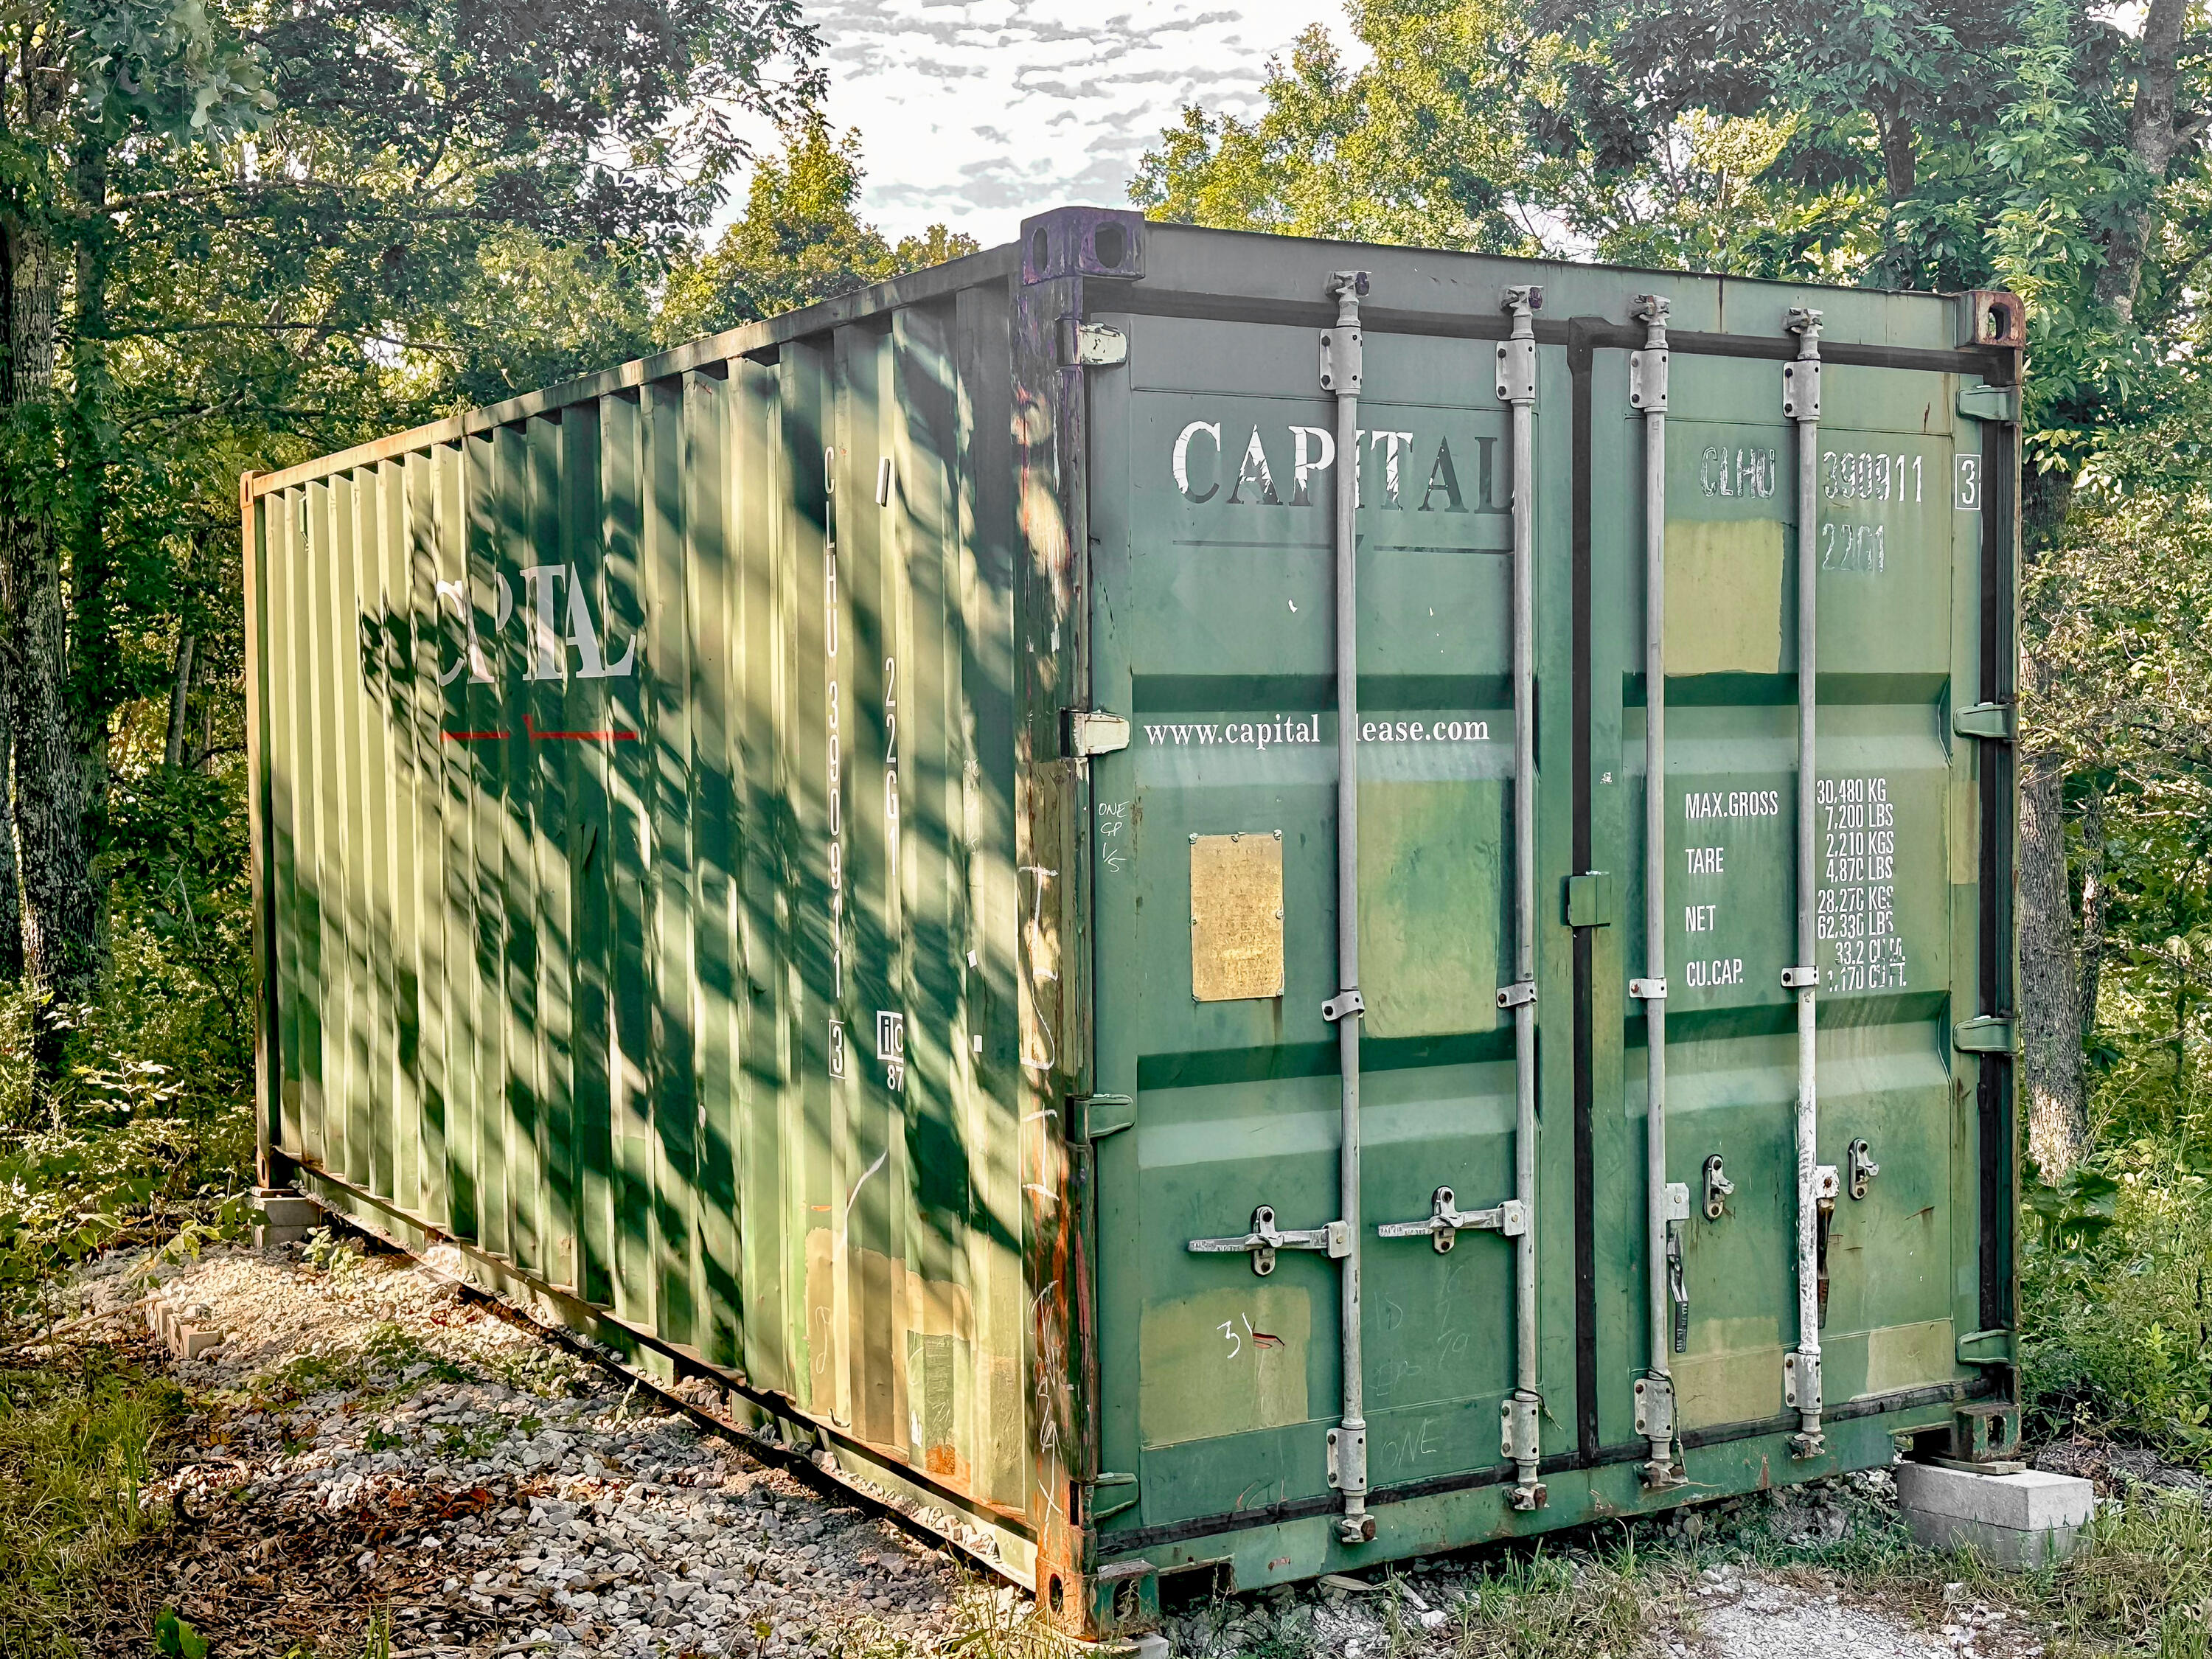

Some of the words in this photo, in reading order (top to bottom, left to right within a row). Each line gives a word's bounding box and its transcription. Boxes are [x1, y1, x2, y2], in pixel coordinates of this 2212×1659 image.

[1700, 447, 1775, 499] CLHU
[1822, 451, 1923, 504] 390911
[1961, 459, 1976, 505] 3
[1143, 713, 1321, 751] www.capital
[1099, 801, 1130, 818] ONE
[1686, 790, 1779, 820] MAX.GROSS
[1816, 779, 1864, 804] 30,480
[1868, 777, 1887, 803] KG
[1825, 804, 1864, 831] 7,200
[1868, 802, 1894, 828] LBS
[1686, 847, 1725, 874] TARE
[1826, 831, 1865, 858] 2,210
[1868, 830, 1894, 855] KGS
[1826, 857, 1865, 883] 4,870
[1868, 855, 1893, 880] LBS
[1686, 905, 1717, 933] NET
[1818, 886, 1865, 914] 28,270
[1868, 885, 1894, 911] KGS
[1818, 912, 1865, 940] 62,330
[1868, 910, 1894, 936] LBS
[1686, 959, 1745, 987] CU.CAP.
[1834, 940, 1865, 966] 33.2
